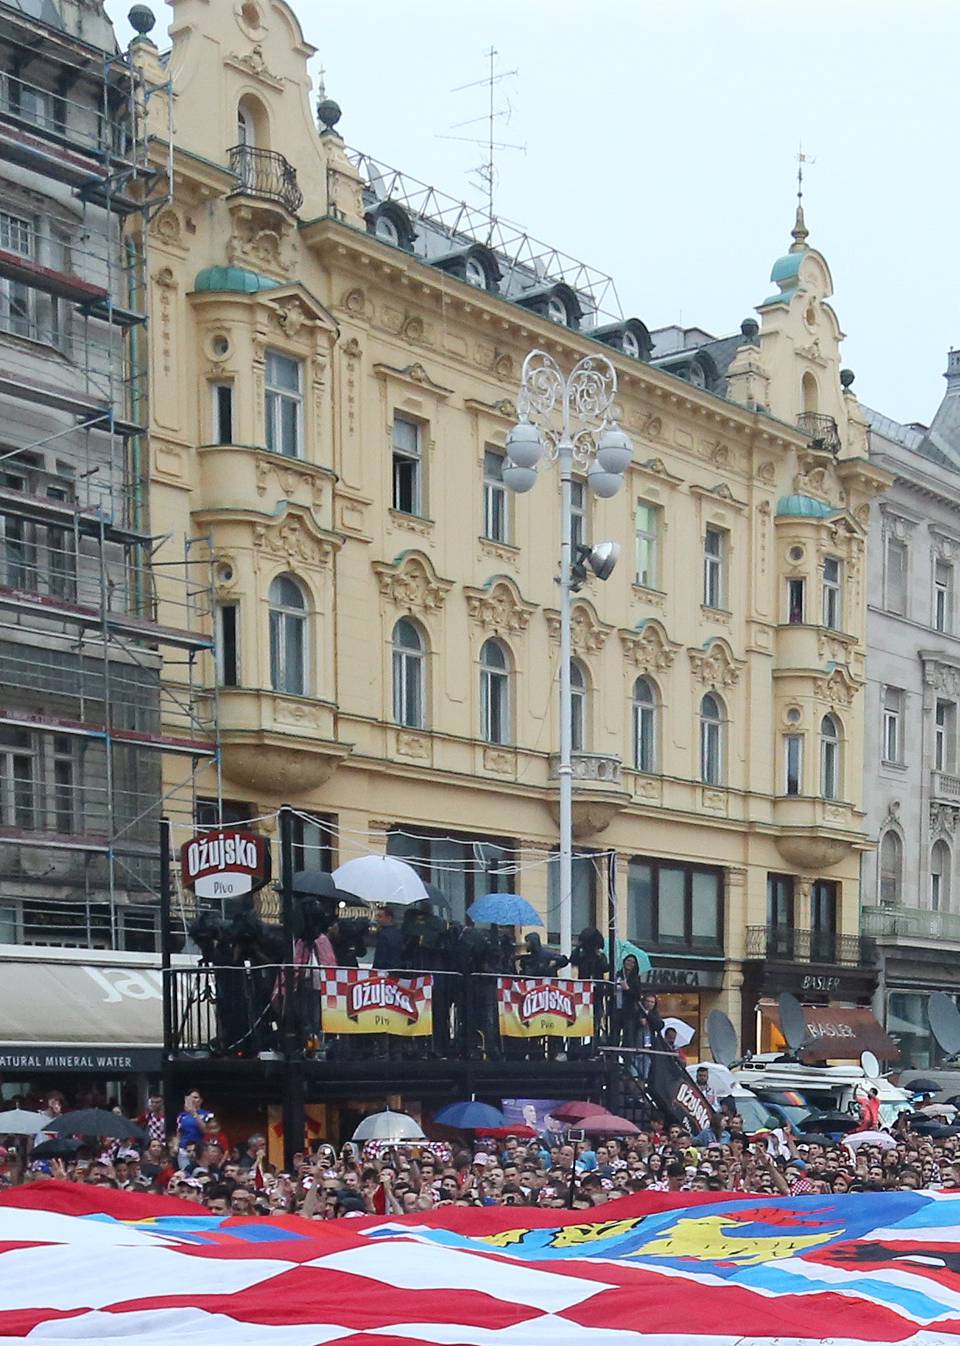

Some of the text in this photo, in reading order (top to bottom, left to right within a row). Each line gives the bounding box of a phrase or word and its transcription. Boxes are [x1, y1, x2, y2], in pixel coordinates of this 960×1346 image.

[188, 834, 257, 876] Ožujsko
[803, 976, 841, 991] BASLER
[523, 987, 573, 1017] Ožujsko
[807, 1022, 856, 1038] BASLER
[45, 1056, 94, 1067] MINERAL
[97, 1056, 132, 1068] WATER
